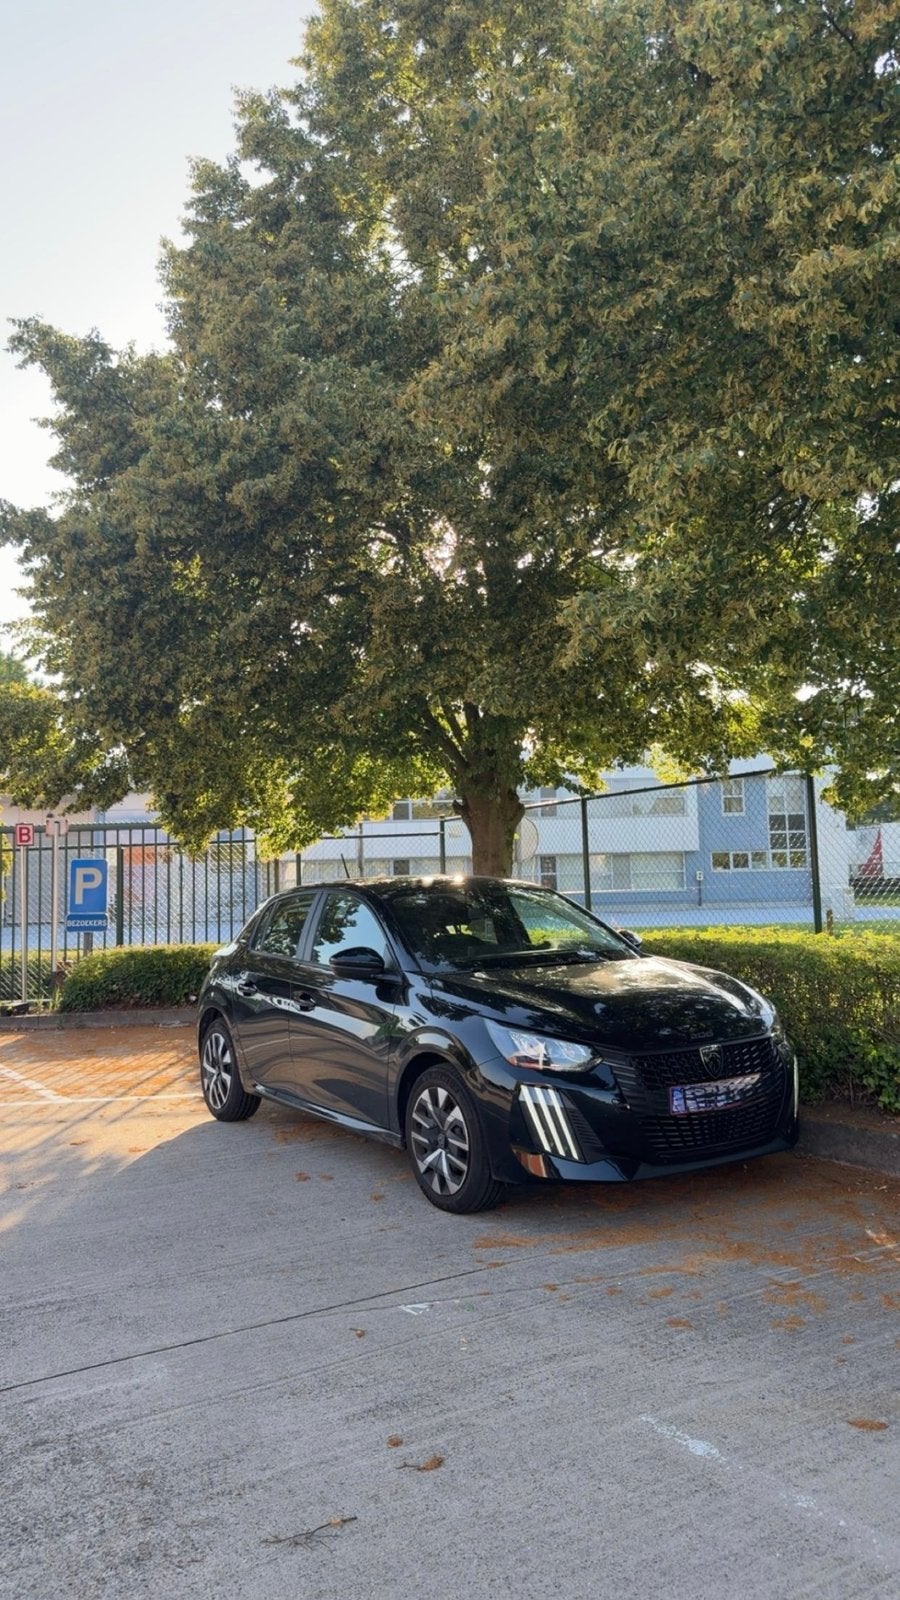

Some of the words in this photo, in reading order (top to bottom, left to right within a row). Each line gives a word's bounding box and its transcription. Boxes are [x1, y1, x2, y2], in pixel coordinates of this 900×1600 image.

[18, 826, 31, 843] B
[75, 867, 103, 905] P
[67, 919, 107, 927] BEZOEKERS
